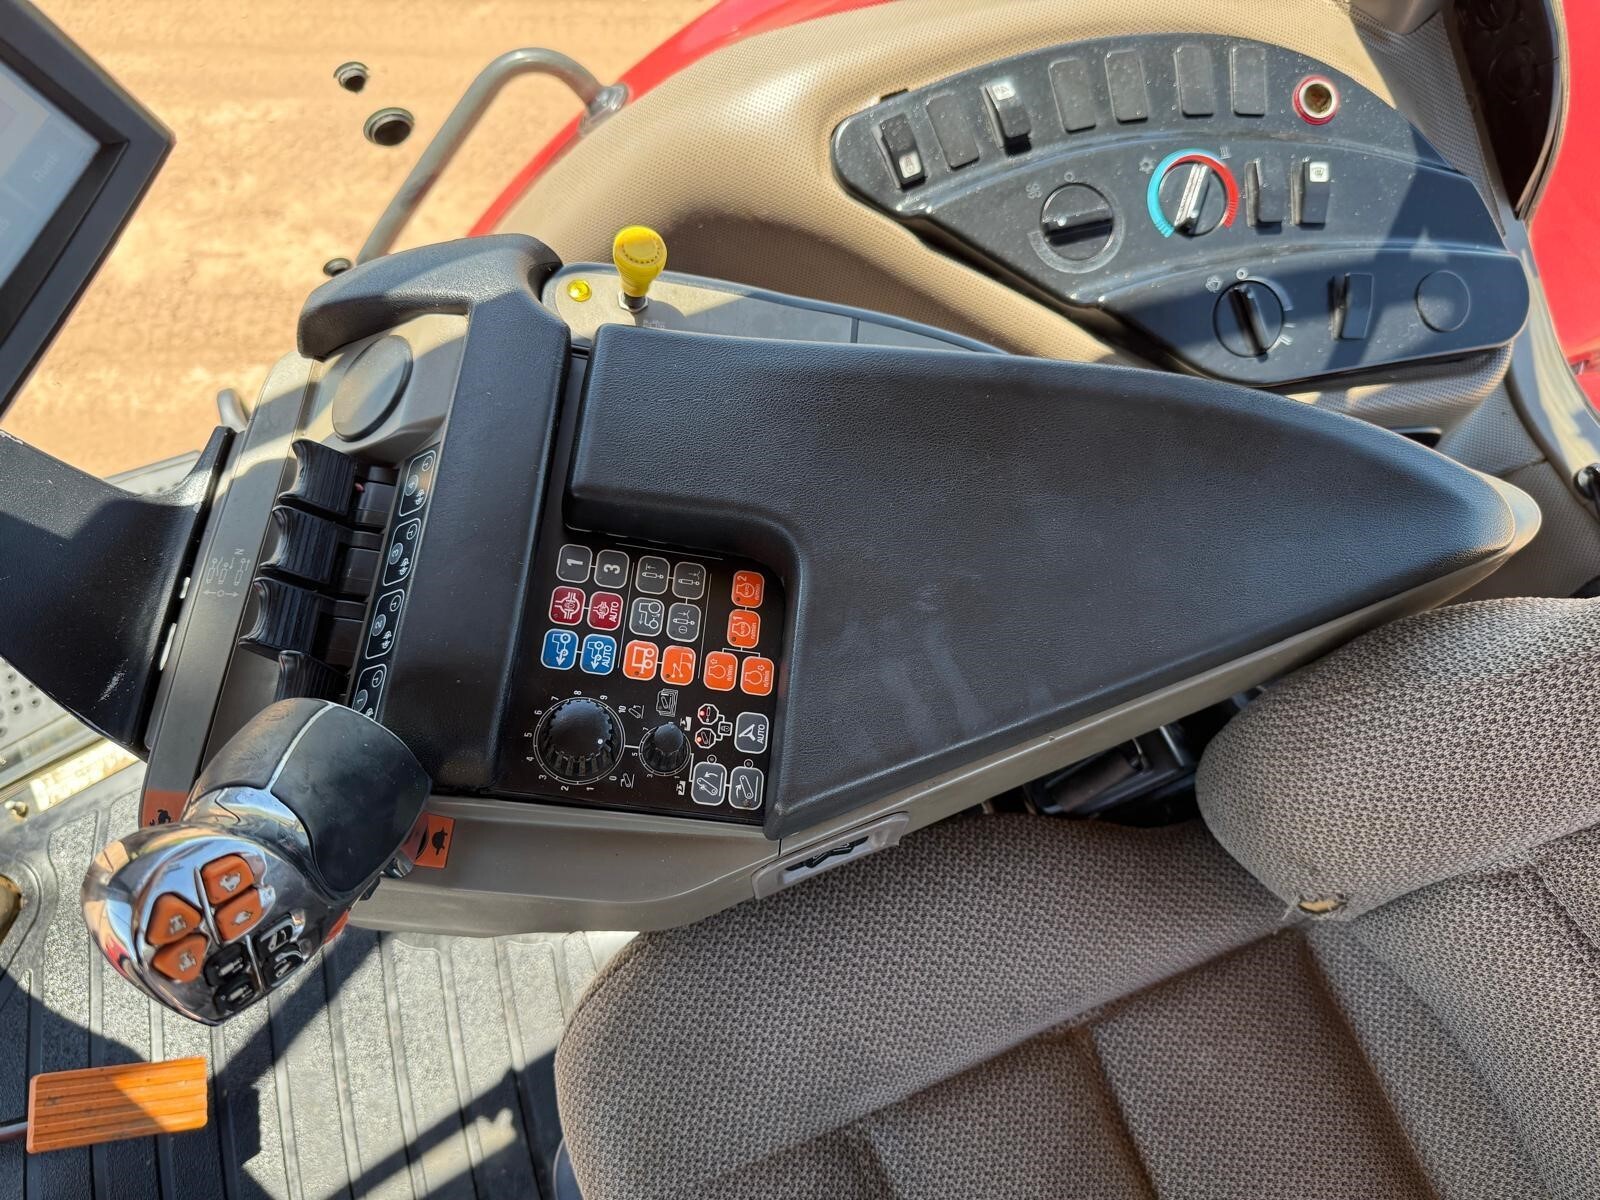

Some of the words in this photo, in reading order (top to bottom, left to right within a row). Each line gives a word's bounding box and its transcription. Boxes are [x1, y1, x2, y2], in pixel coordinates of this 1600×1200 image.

[566, 558, 583, 566] 1
[604, 564, 620, 574] 3
[609, 602, 619, 622] AUTO
[375, 620, 382, 629] 2
[602, 645, 612, 667] AUTO
[618, 705, 627, 713] 10
[757, 724, 766, 744] AUTO
